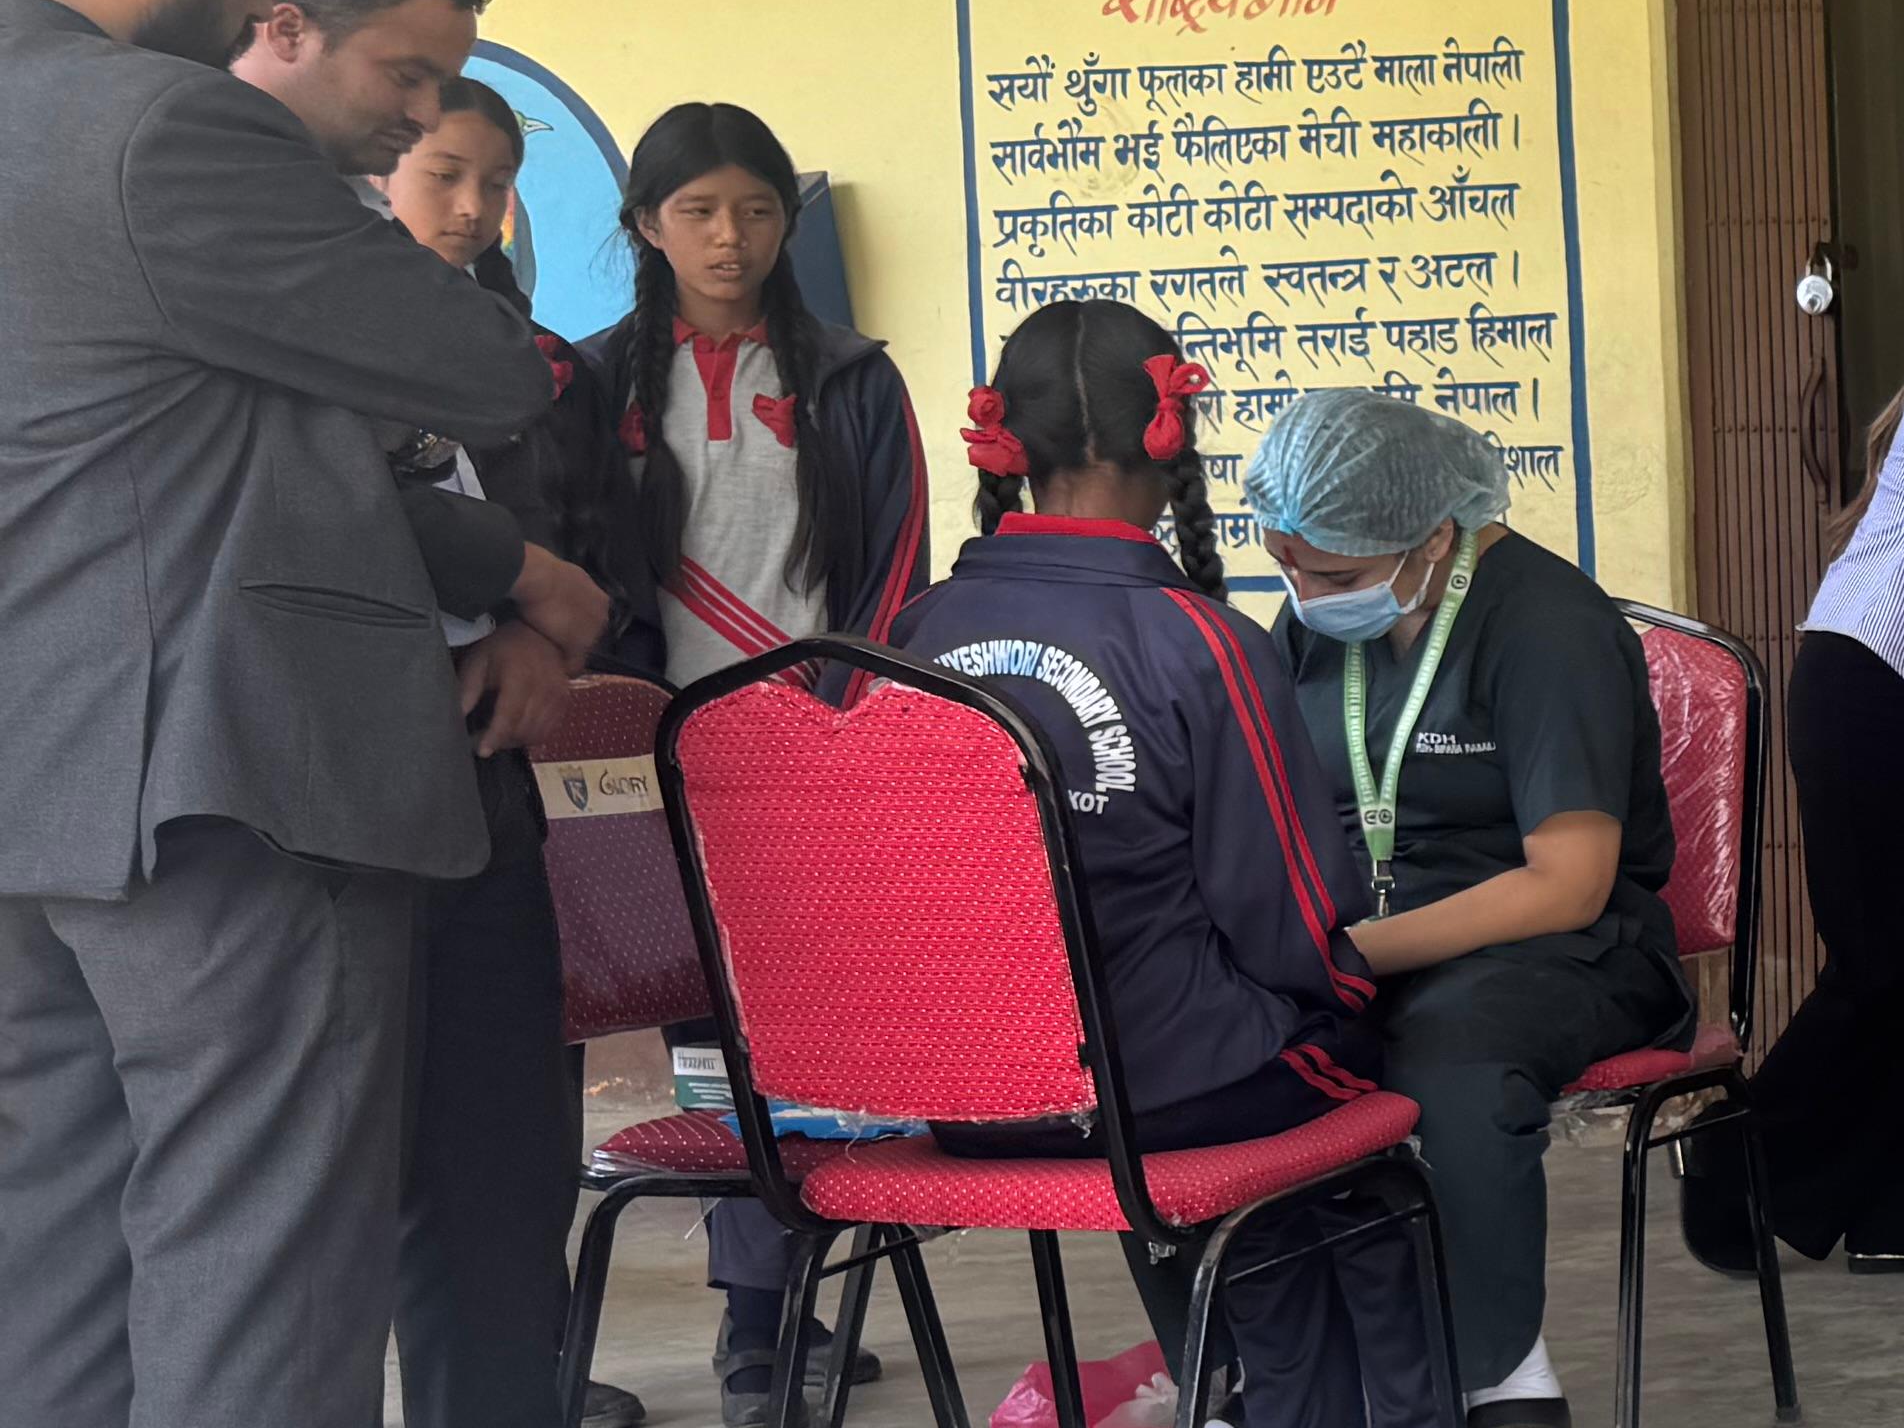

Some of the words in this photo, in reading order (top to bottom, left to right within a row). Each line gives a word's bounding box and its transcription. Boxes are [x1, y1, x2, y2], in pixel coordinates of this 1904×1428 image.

[1233, 44, 1297, 100] हामी
[1372, 53, 1438, 99] माला
[1442, 36, 1526, 100] नेपाली
[1113, 126, 1165, 185] भई
[1298, 104, 1362, 164] मेची
[1371, 97, 1505, 164] महाकाली
[993, 190, 1120, 257] प्रकृतिका
[1126, 183, 1199, 241] कोटी
[1203, 179, 1279, 240] कोटी
[1283, 169, 1419, 241] सम्पदाको
[1149, 245, 1249, 314] रगतले
[1402, 251, 1499, 301] अटल
[1294, 306, 1378, 372] तराई
[1380, 317, 1461, 367] पहाड
[1465, 302, 1559, 369] हिमाल
[1432, 367, 1522, 424] नेपाल
[1036, 645, 1122, 728] SECONDARY
[1088, 724, 1137, 793] SCHOOL
